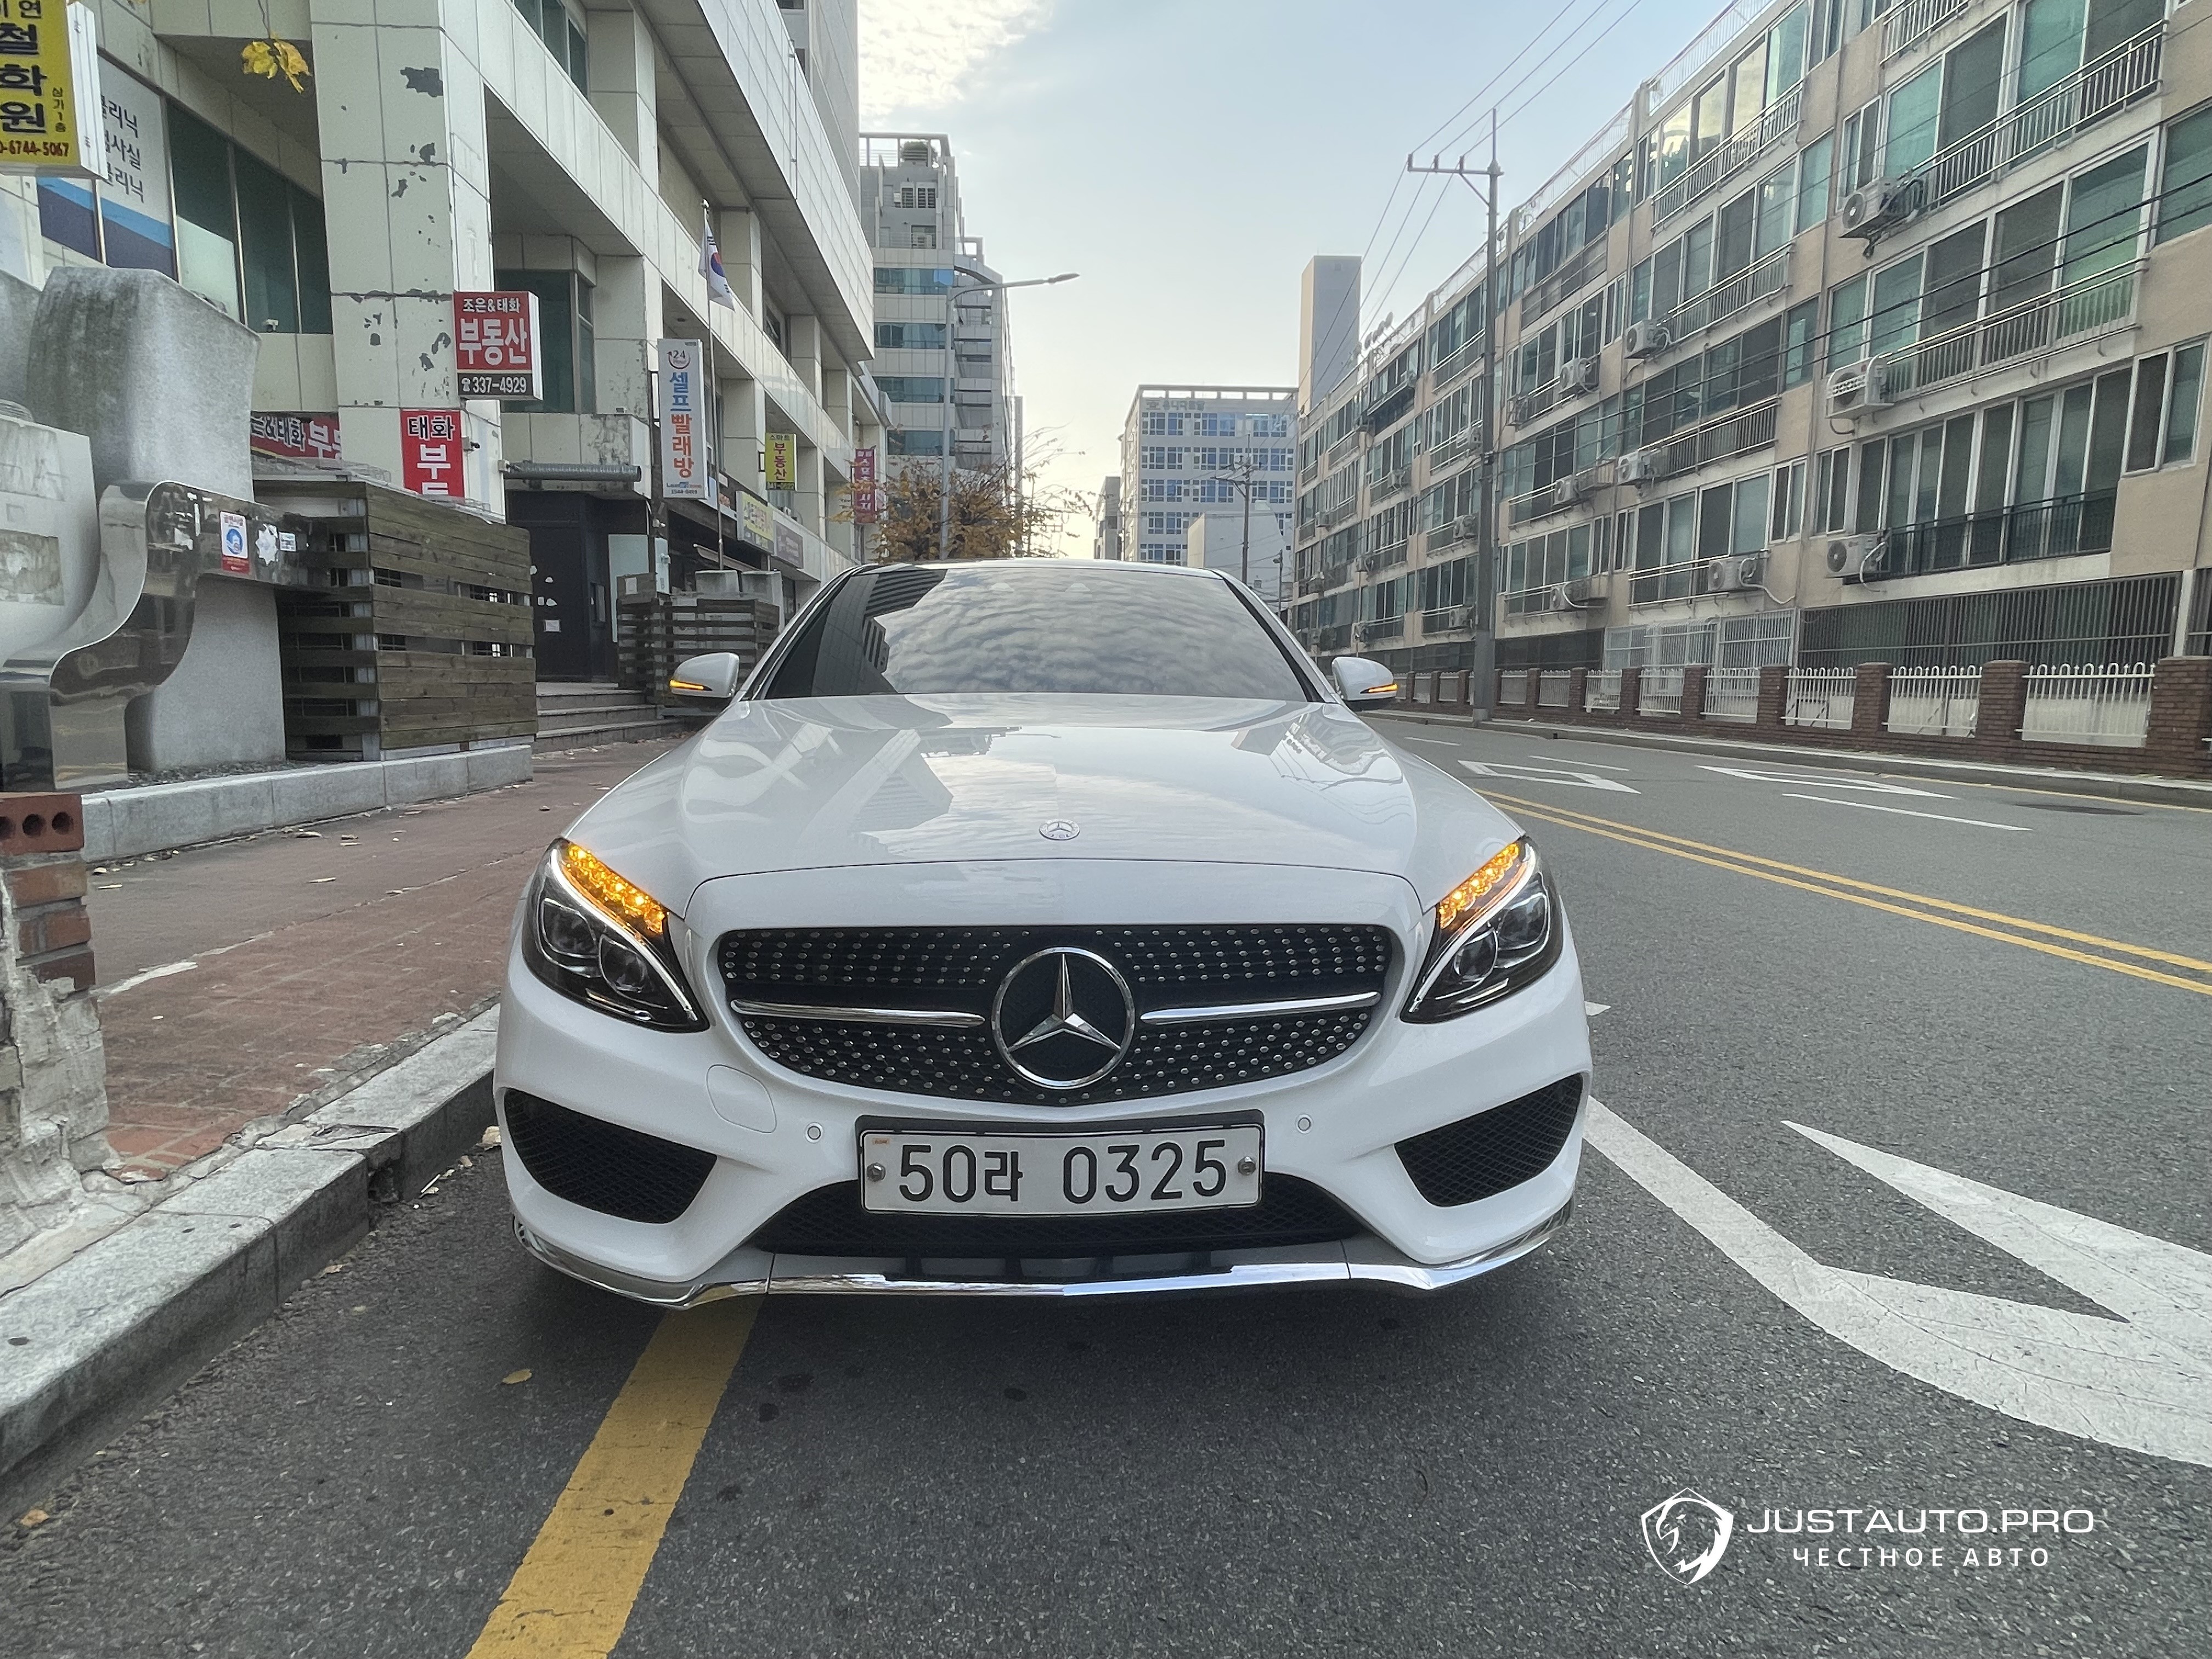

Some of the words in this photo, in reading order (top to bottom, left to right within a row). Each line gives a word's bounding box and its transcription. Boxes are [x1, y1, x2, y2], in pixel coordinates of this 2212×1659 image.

[463, 297, 521, 314] 조은&태화
[459, 318, 528, 366] 부동산
[673, 350, 686, 359] 24
[472, 376, 527, 394] 337-4929
[407, 415, 455, 441] 태화
[774, 442, 787, 481] 부동산
[899, 1144, 1023, 1203] 50라
[1062, 1139, 1227, 1204] 0325
